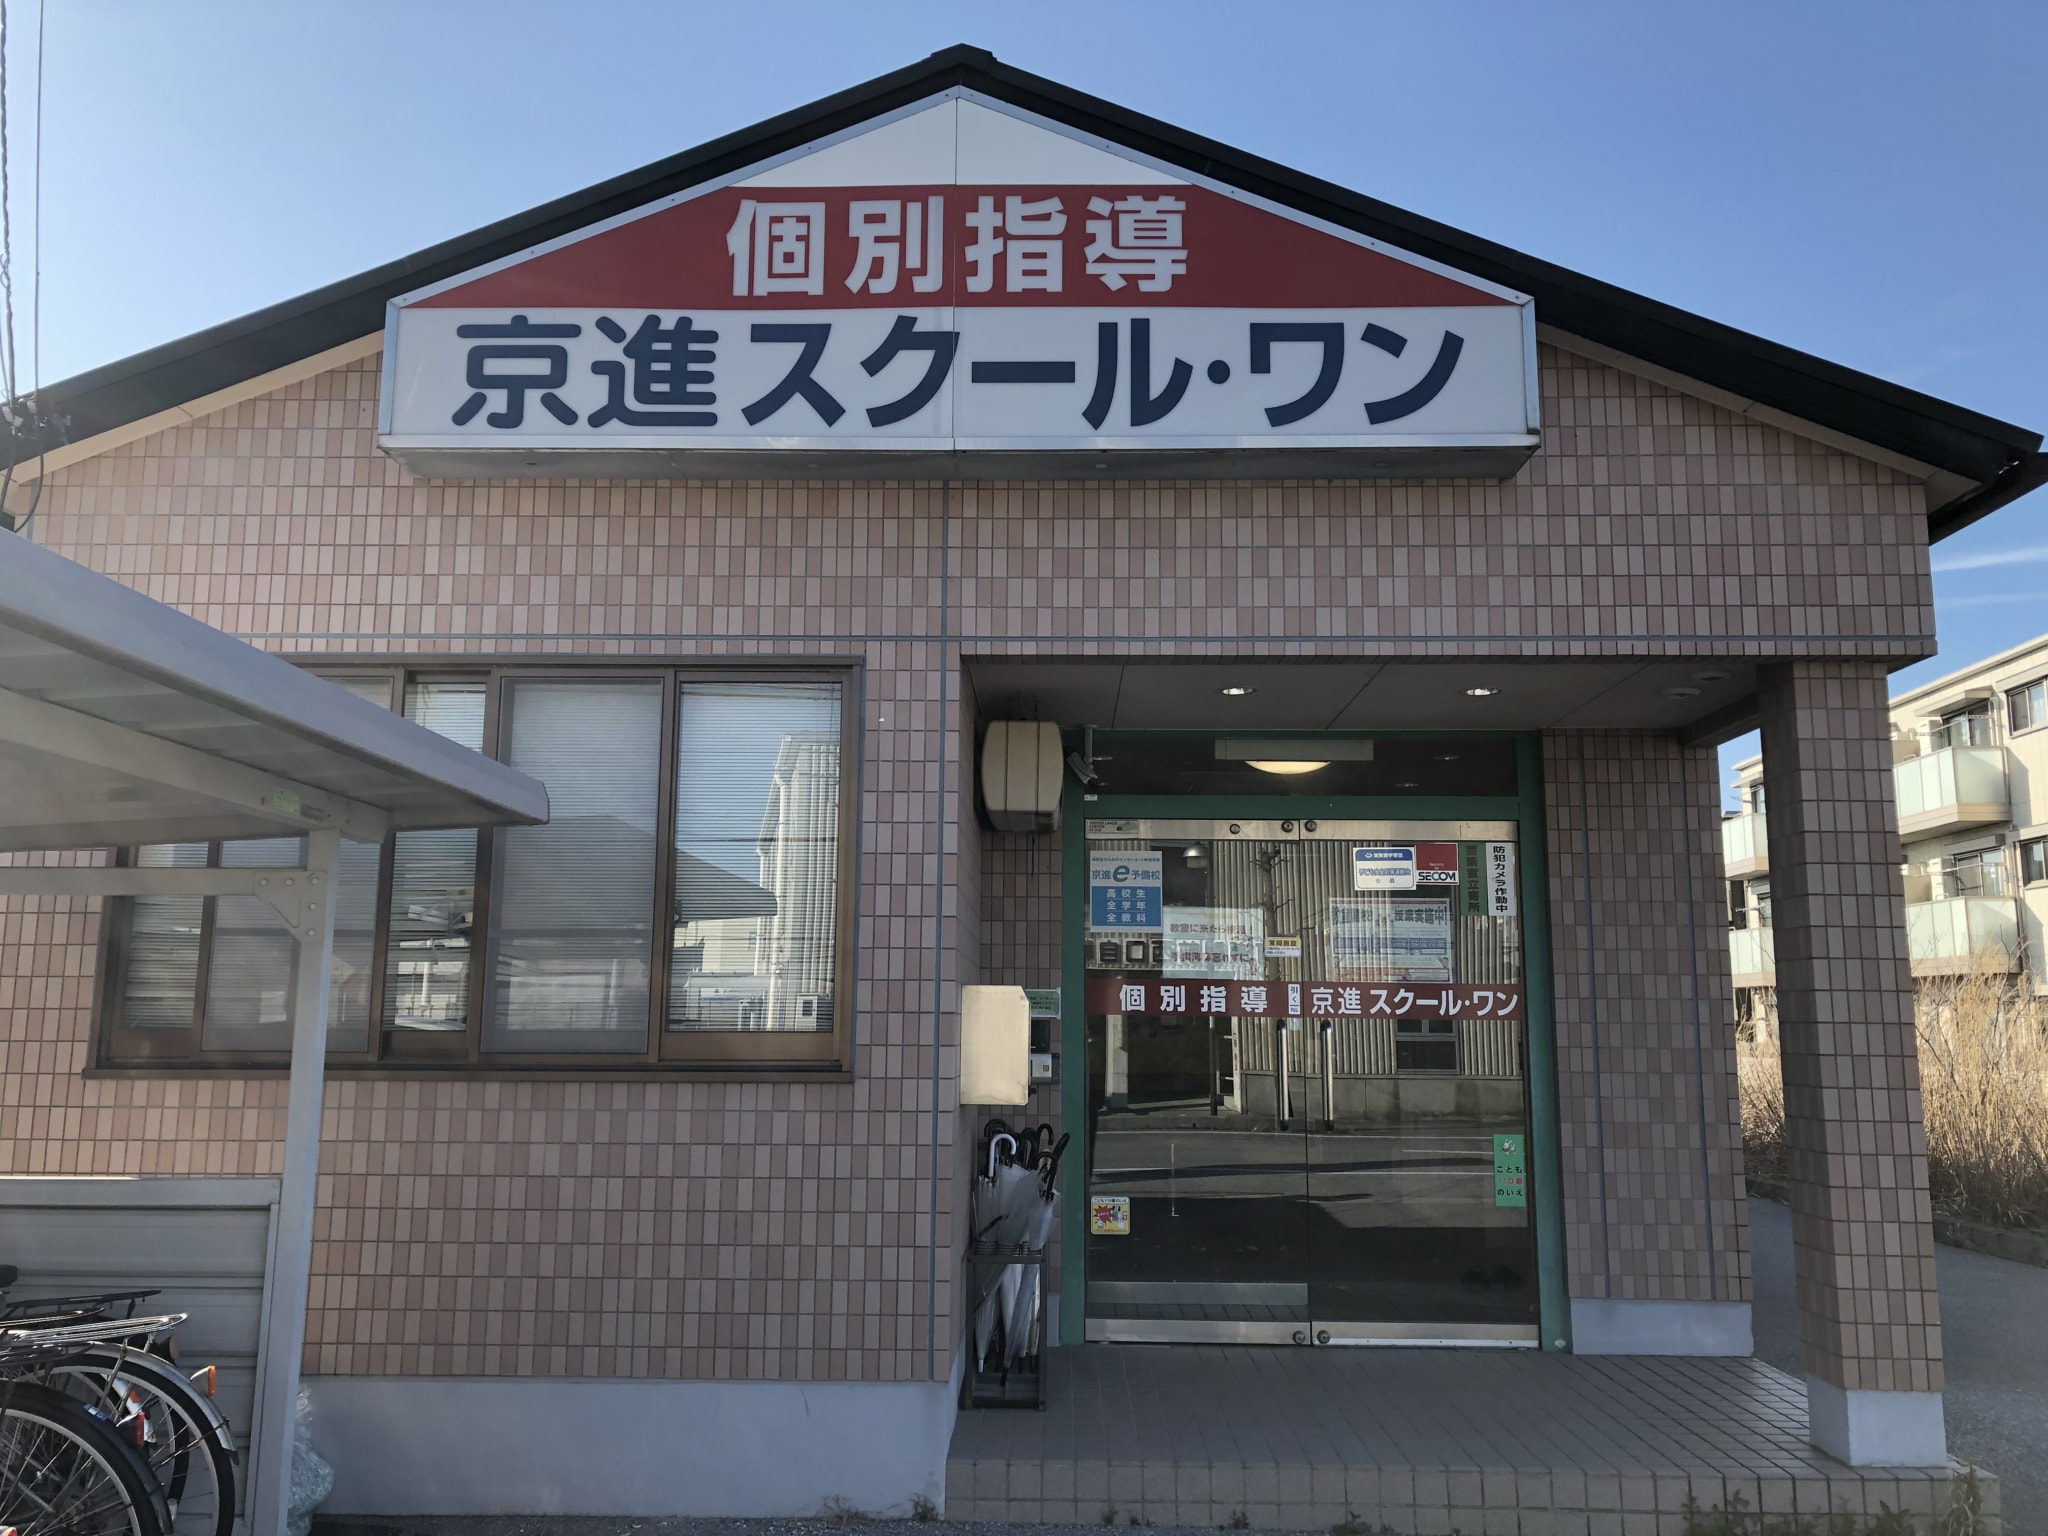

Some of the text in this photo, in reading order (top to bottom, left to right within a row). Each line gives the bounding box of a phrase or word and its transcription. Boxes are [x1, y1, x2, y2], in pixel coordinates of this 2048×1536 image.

[726, 195, 1188, 297] 個別指導
[451, 313, 1465, 431] 京進スクール・ワン
[1091, 864, 1161, 882] 京進e予備校
[1418, 871, 1456, 881] SECOM
[1492, 845, 1509, 913] 防犯カメラ作動中
[1106, 888, 1146, 898] 高校生
[1106, 901, 1146, 911] 全学年
[1106, 913, 1146, 923] 全教科
[1119, 984, 1268, 1013] 個別指導
[1290, 986, 1299, 1003] 引く
[1310, 986, 1519, 1017] 京進スクール・ワン
[1496, 1188, 1523, 1197] のいえ
